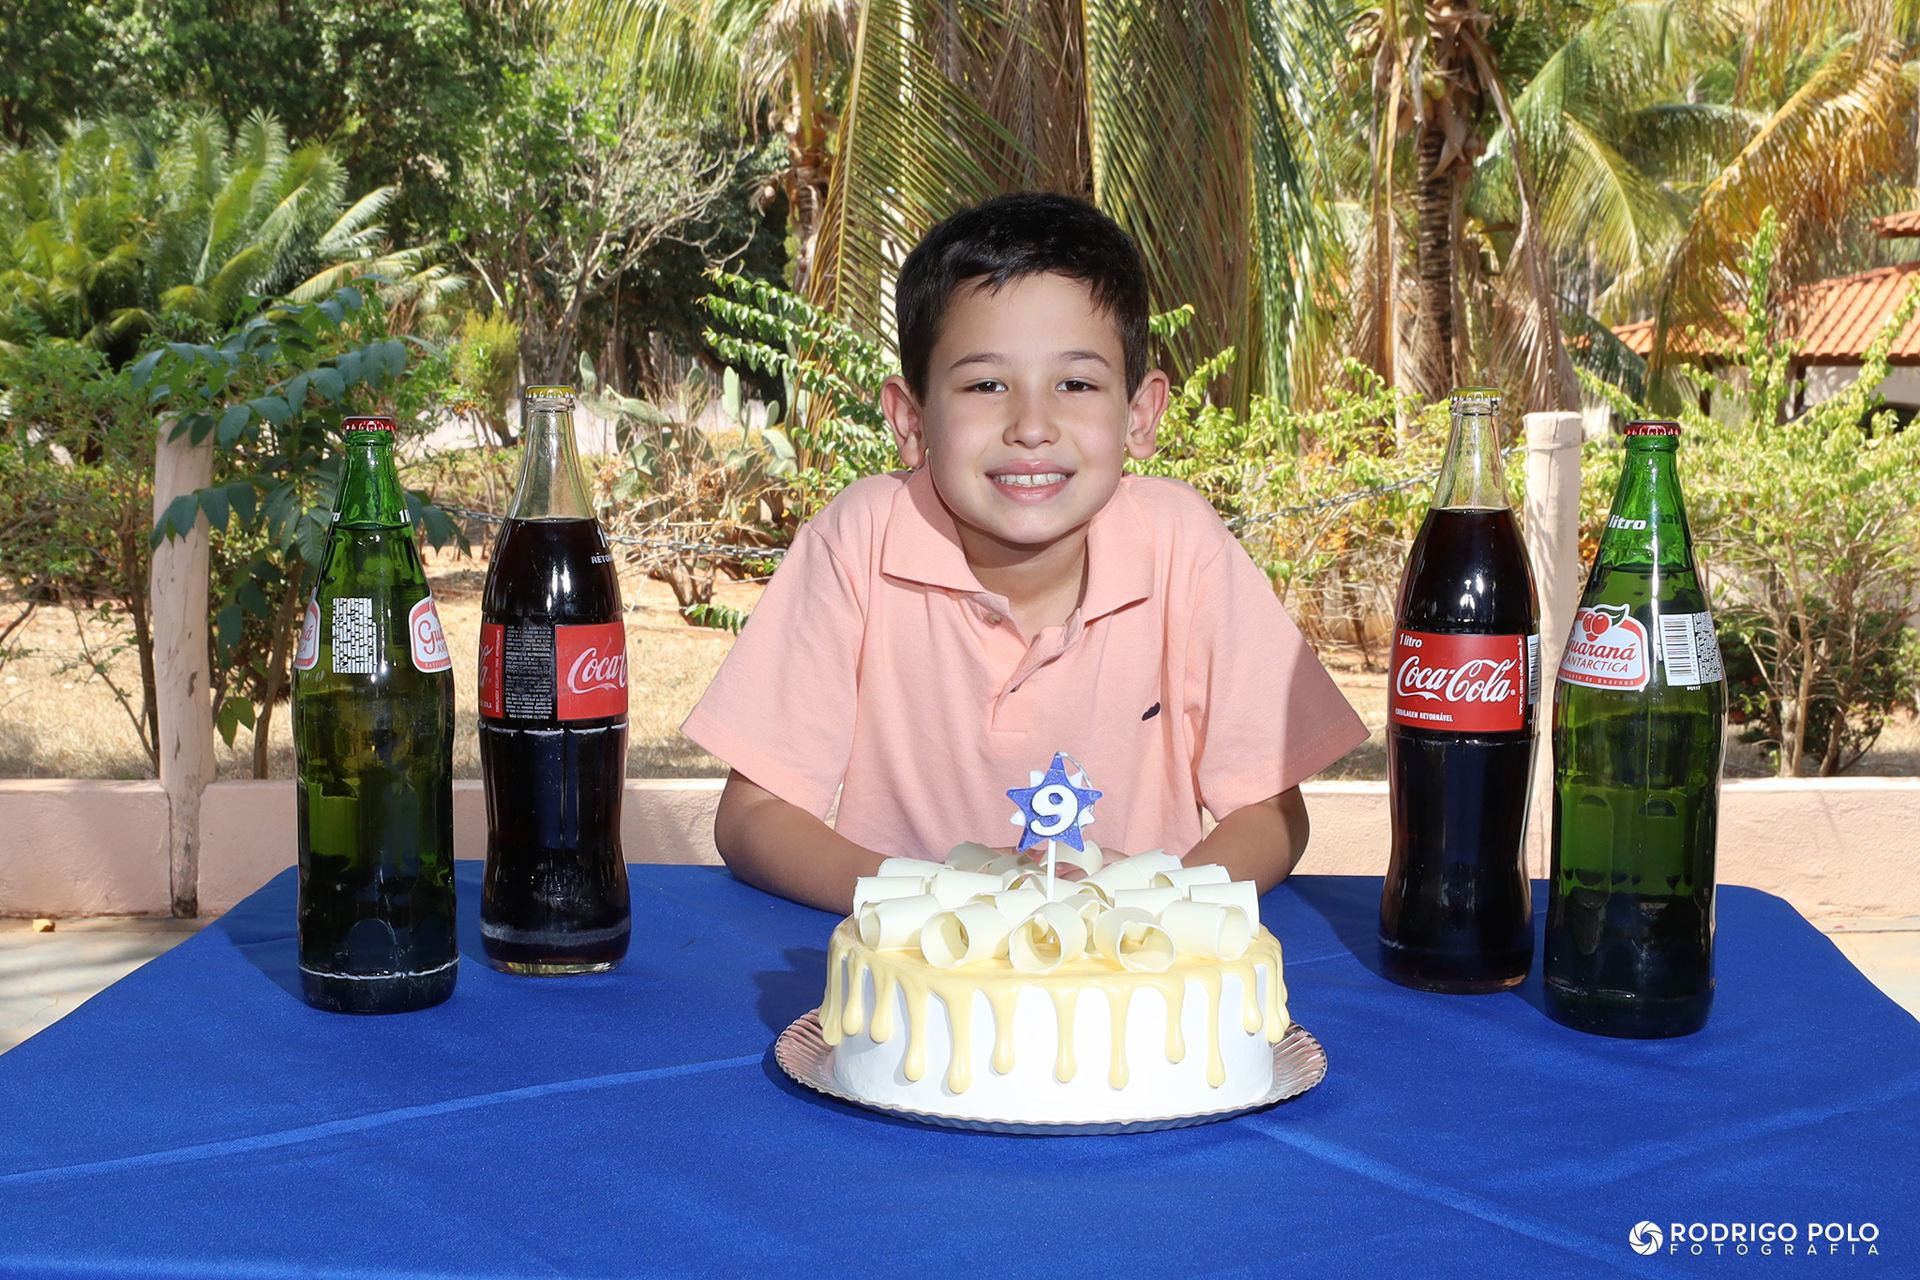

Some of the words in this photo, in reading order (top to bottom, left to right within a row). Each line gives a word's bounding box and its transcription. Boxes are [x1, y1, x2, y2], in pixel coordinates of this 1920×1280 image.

[1608, 515, 1647, 530] litro
[1404, 634, 1423, 648] litro
[1396, 655, 1517, 702] Coca-Cola
[1030, 784, 1078, 836] 9
